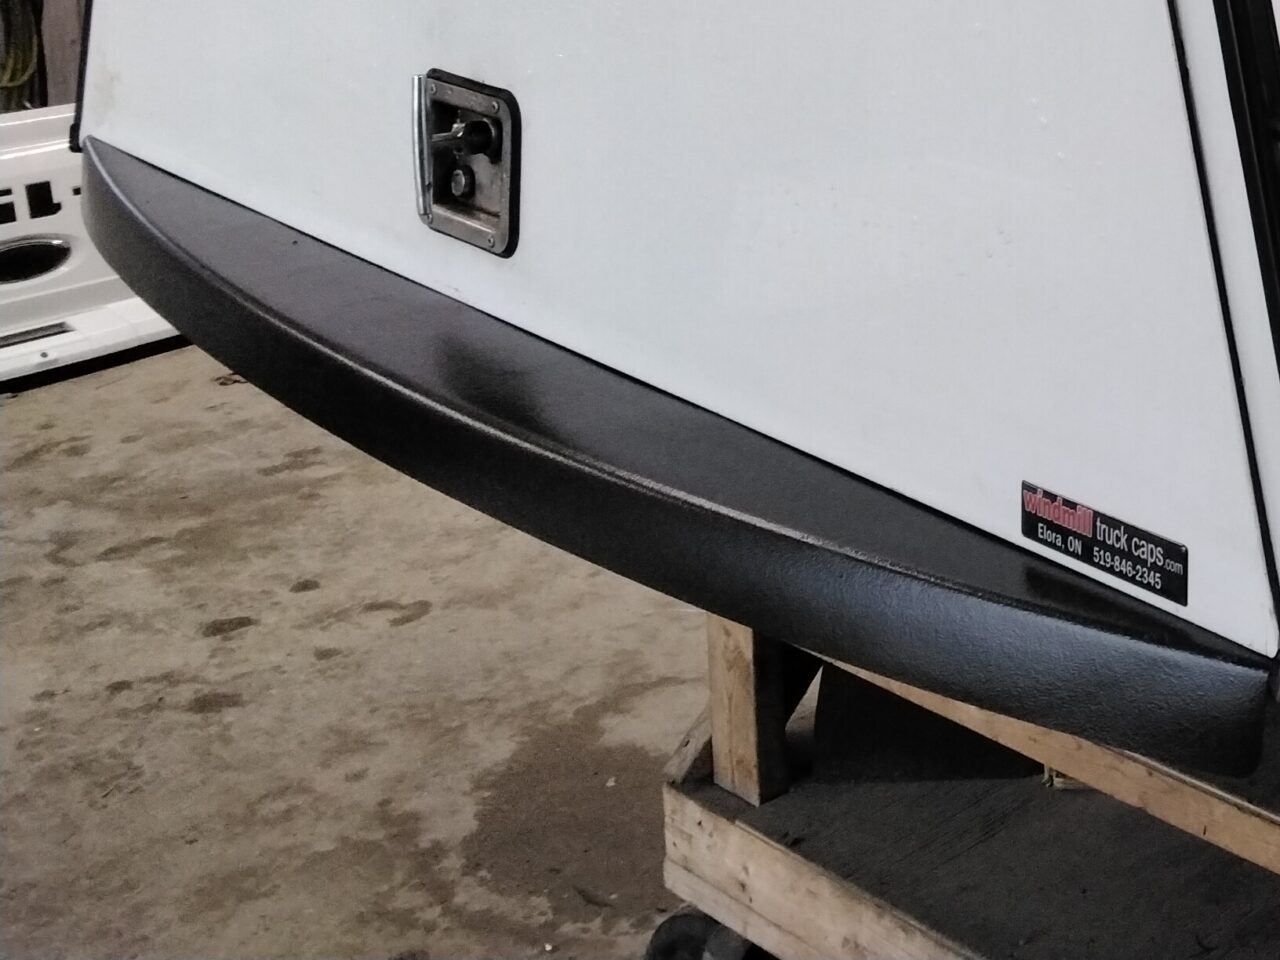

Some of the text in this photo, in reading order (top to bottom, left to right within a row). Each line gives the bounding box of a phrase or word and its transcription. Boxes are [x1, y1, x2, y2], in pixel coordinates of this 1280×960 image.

[1023, 489, 1094, 538] windmill
[1096, 517, 1128, 552] truck
[1037, 523, 1162, 590] Elora, ON 519-846-2345
